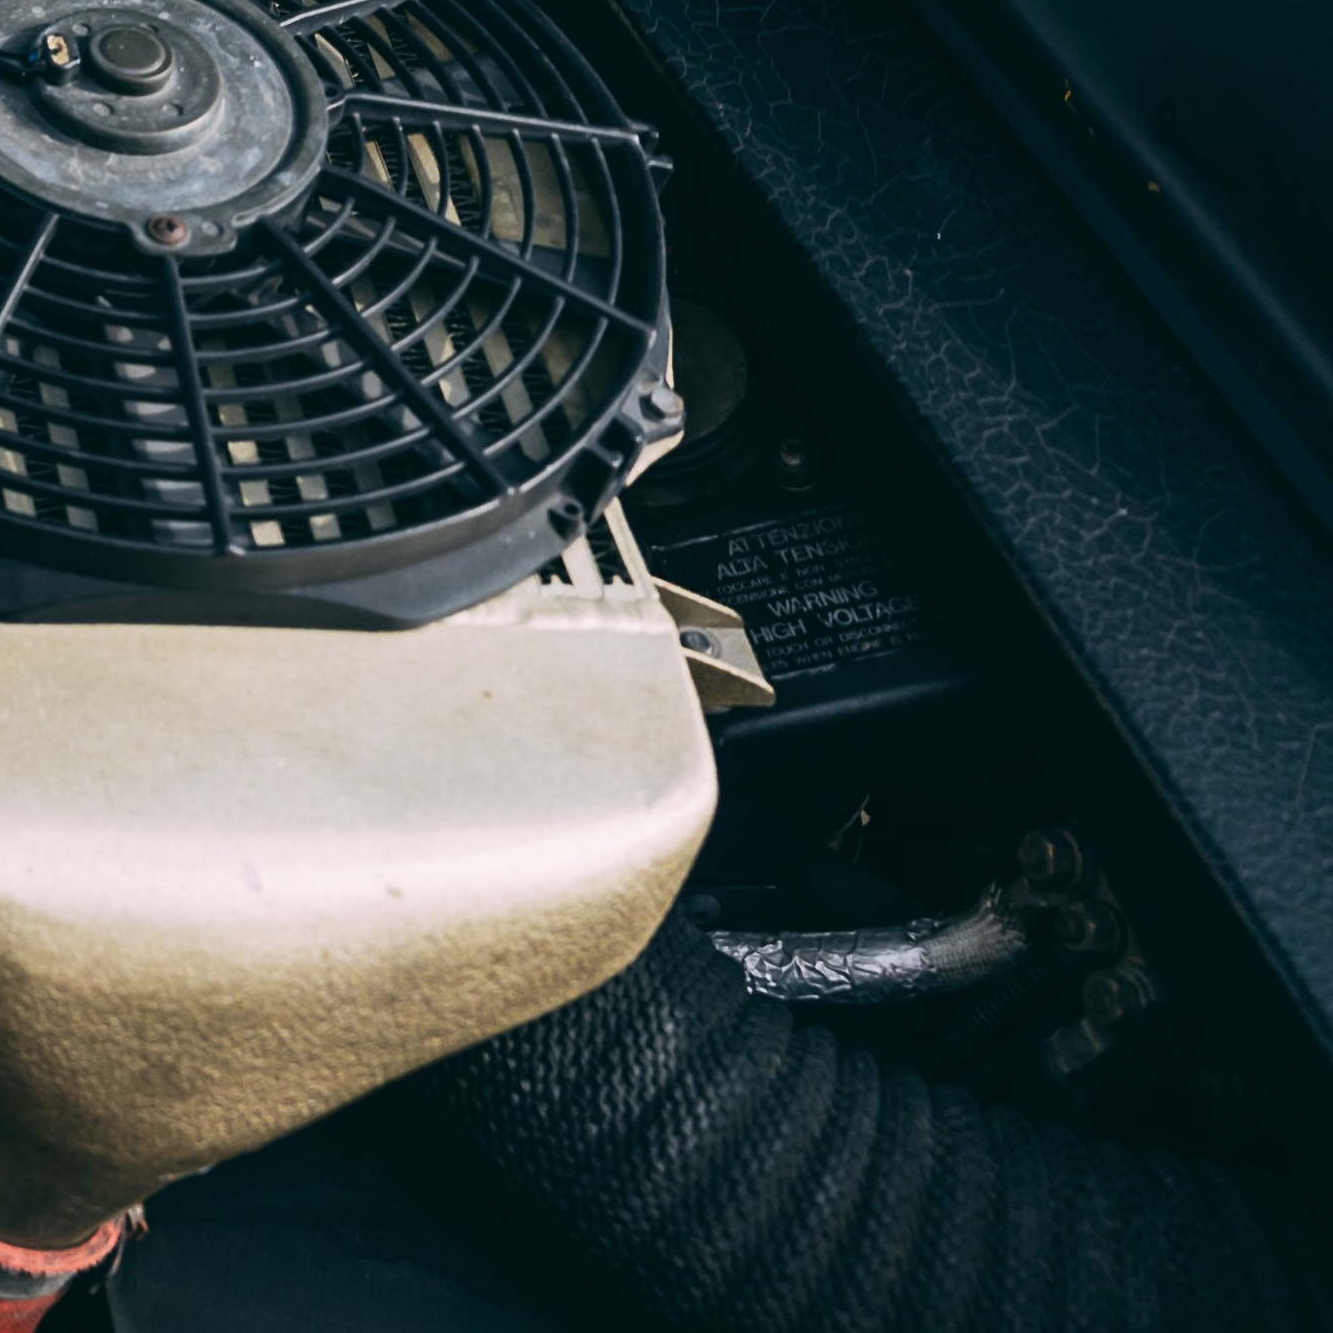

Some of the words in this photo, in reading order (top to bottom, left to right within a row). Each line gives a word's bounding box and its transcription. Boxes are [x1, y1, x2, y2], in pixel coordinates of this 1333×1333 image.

[717, 553, 769, 581] ALTA
[767, 580, 879, 618] WARNING
[749, 617, 808, 645] HIGH
[815, 593, 923, 629] VOLTAGE
